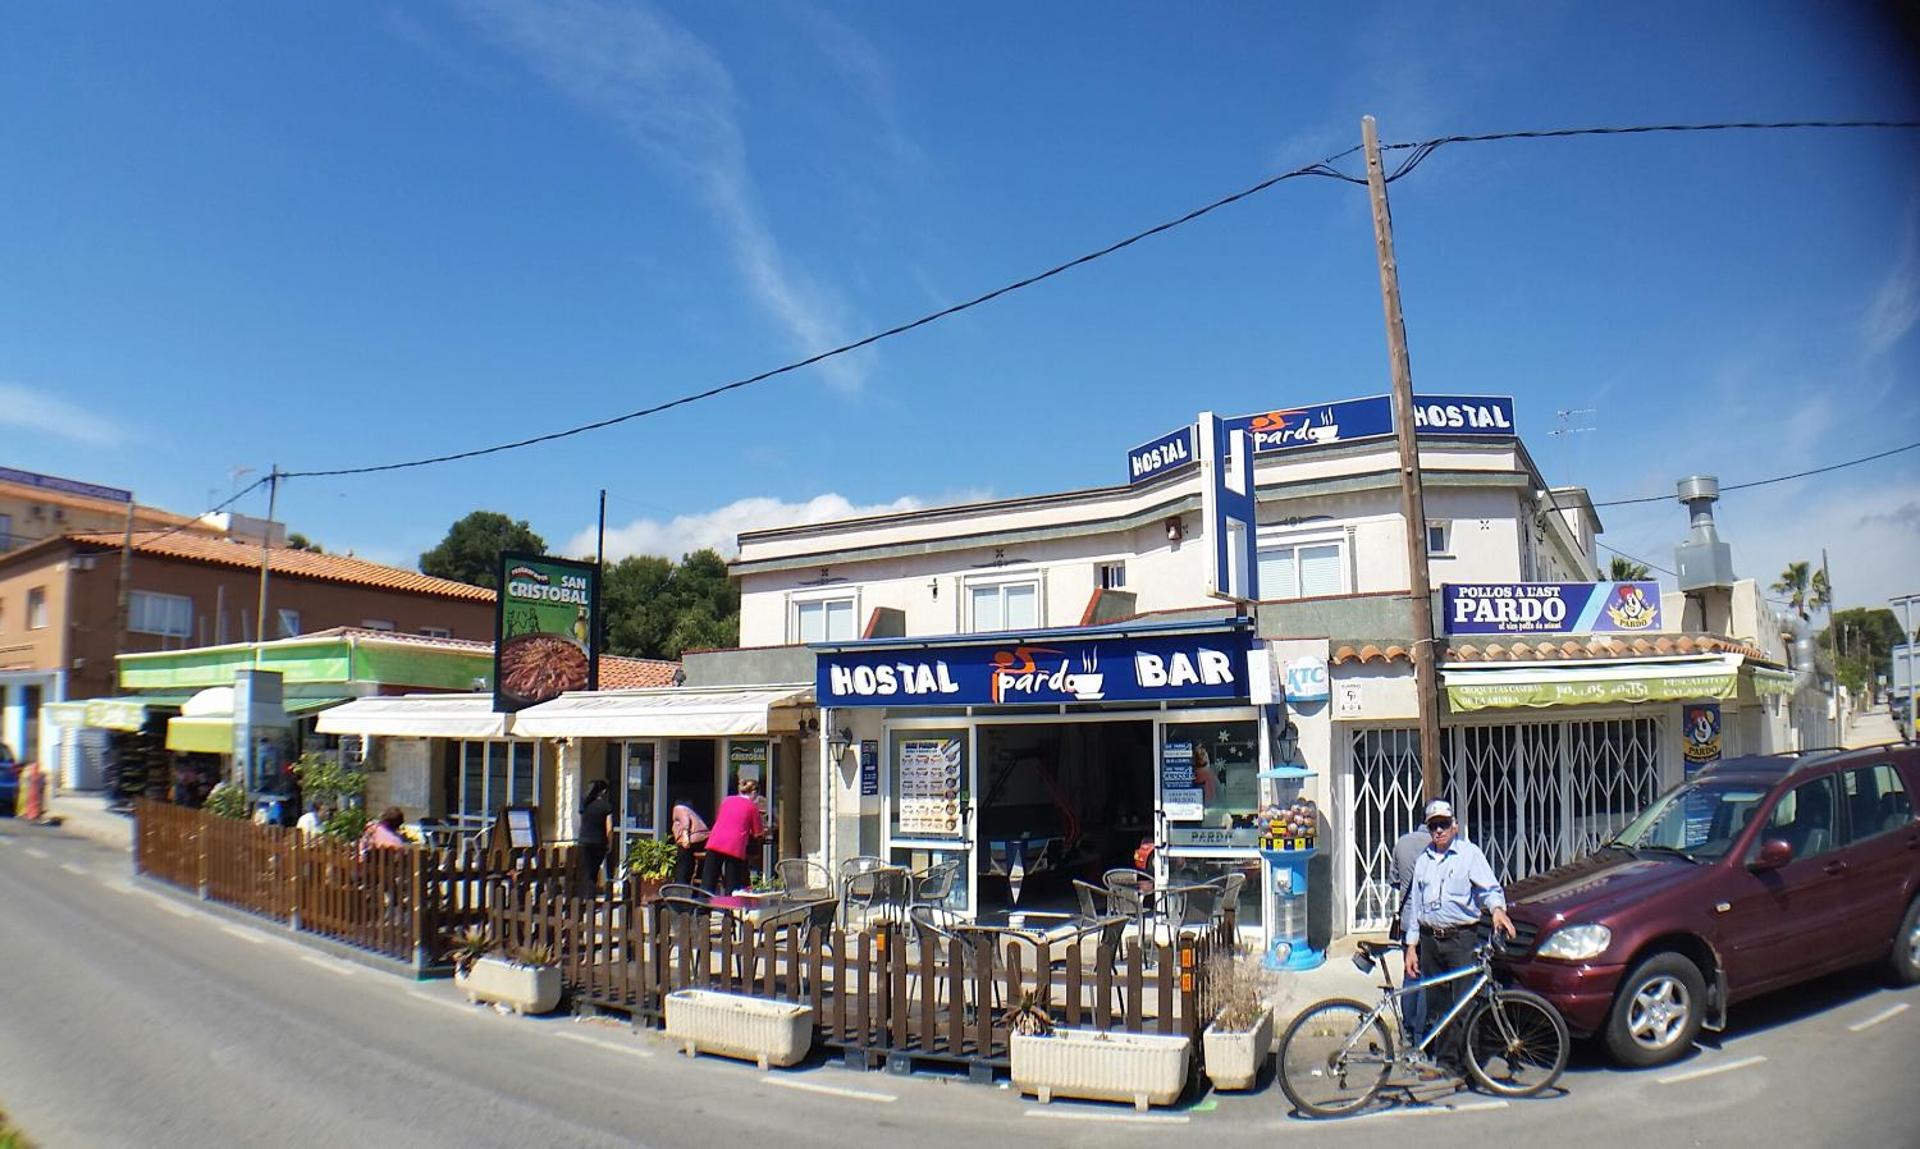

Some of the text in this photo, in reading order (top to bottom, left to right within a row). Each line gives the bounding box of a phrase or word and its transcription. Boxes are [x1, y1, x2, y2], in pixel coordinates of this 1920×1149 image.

[1413, 404, 1511, 428] HOSTAL
[1132, 439, 1188, 477] HOSTAL
[508, 581, 588, 604] CRISTOBAL
[561, 575, 586, 589] SAN
[1458, 586, 1512, 598] POLLOS
[1514, 586, 1524, 597] A
[1453, 597, 1567, 623] PARDO
[831, 661, 959, 696] HOSTAL
[1134, 647, 1235, 687] BAR
[1688, 744, 1718, 756] PARDO
